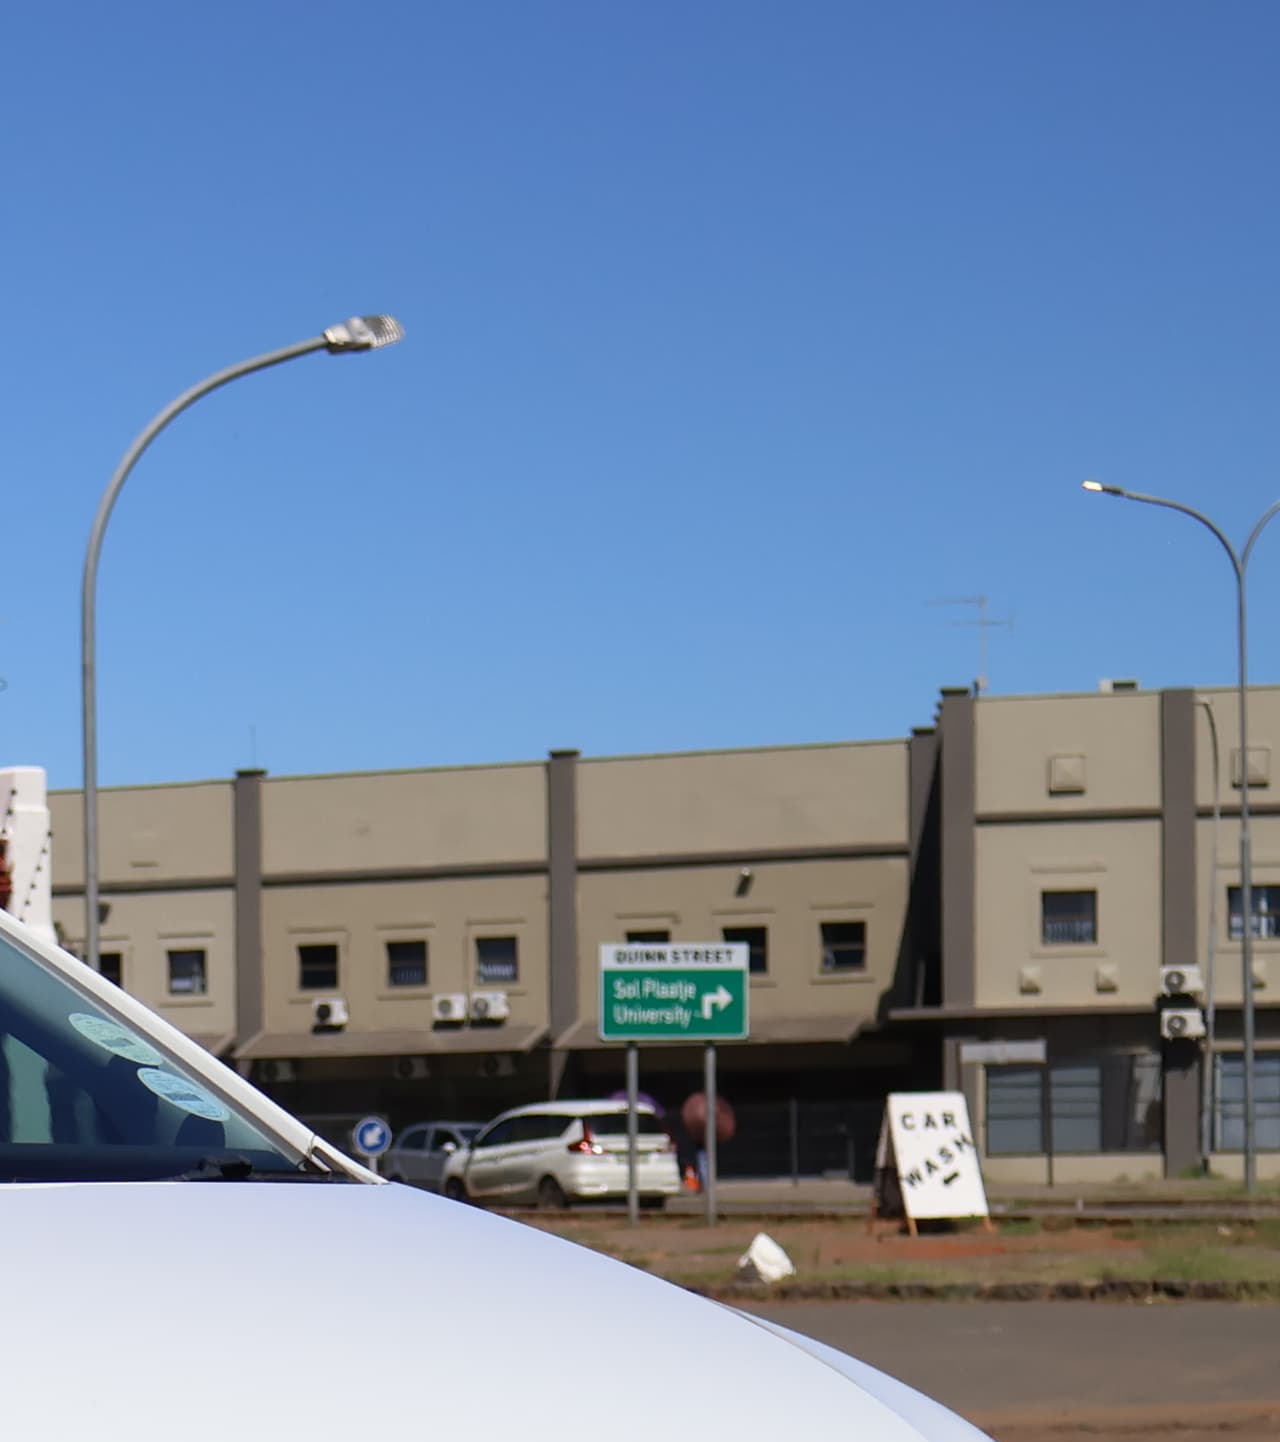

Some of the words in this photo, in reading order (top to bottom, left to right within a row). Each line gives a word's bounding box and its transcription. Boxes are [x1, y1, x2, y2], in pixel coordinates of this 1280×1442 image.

[615, 950, 667, 963] QUINN
[671, 949, 734, 963] STREET
[613, 978, 640, 999] Sol
[643, 978, 697, 1002] Plaatje
[613, 1005, 692, 1029] University
[901, 1112, 956, 1130] CAR
[905, 1132, 972, 1188] WASH
